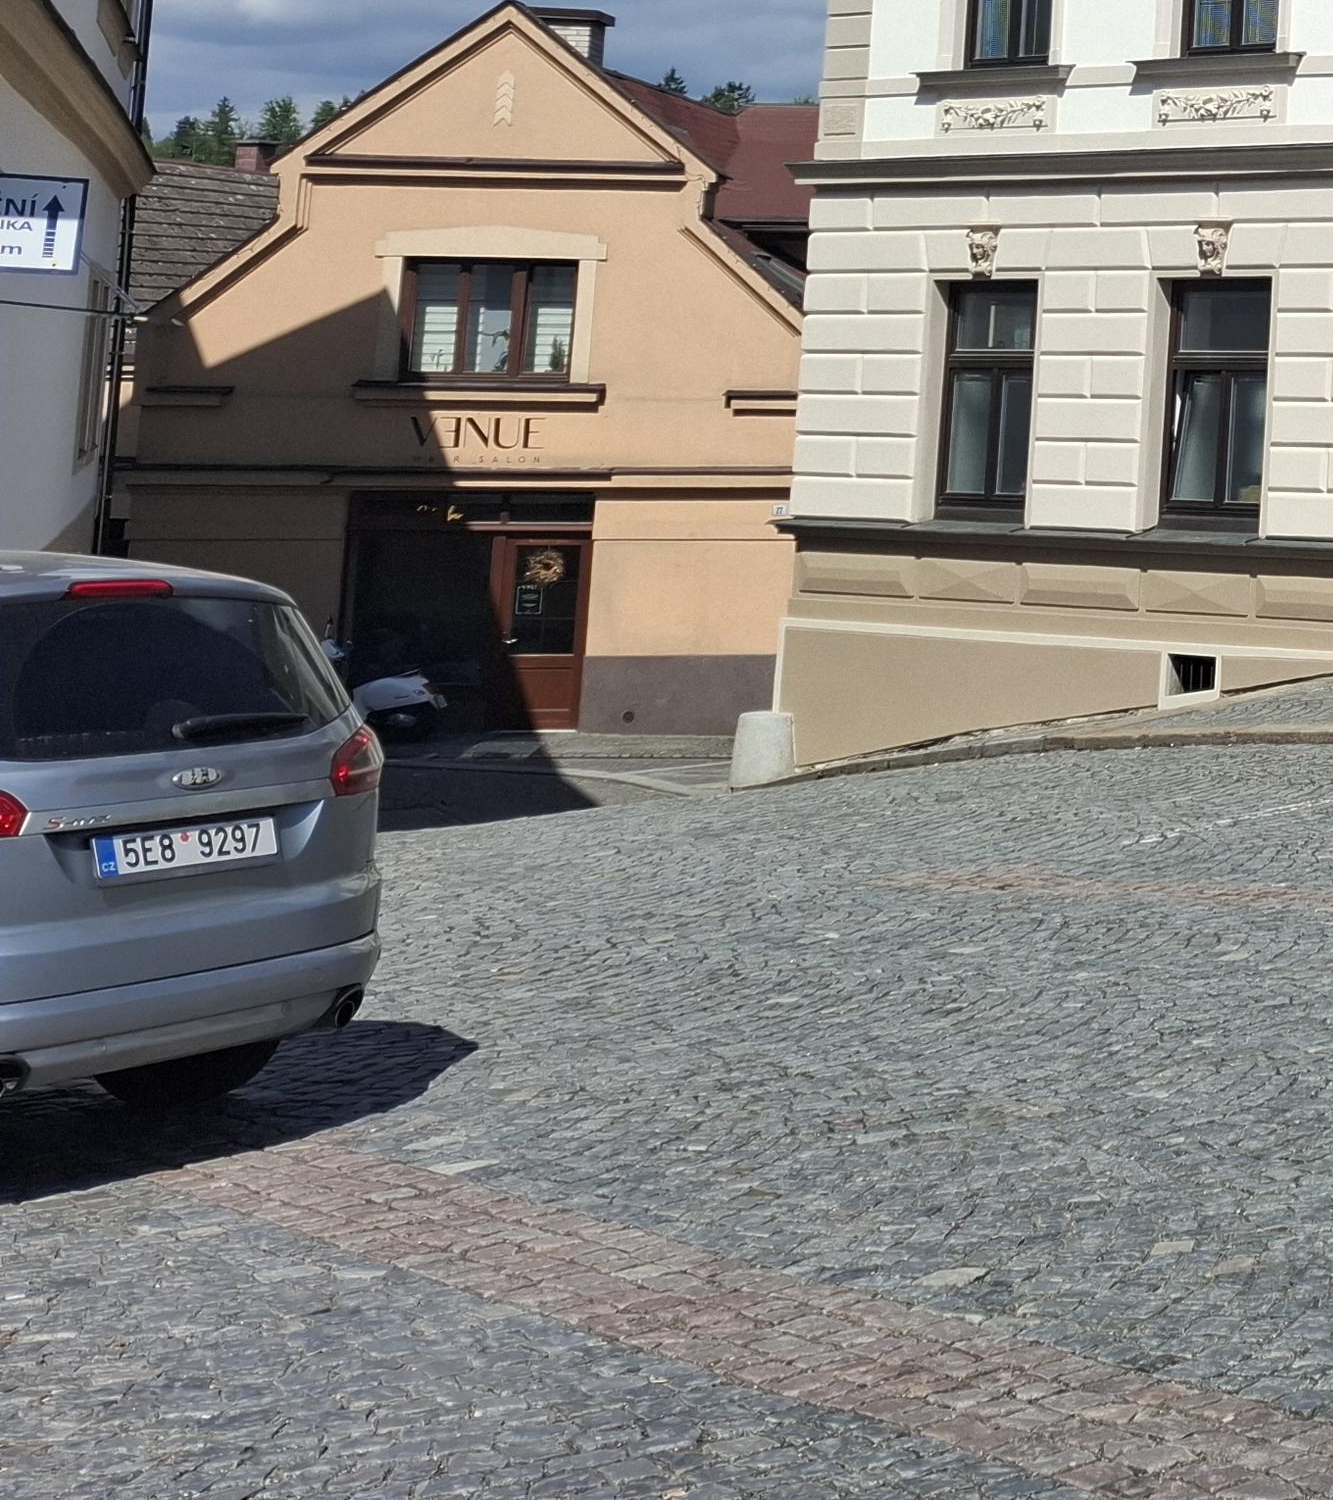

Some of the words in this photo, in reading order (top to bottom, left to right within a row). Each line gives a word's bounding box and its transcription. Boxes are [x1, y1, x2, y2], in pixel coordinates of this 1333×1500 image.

[0, 190, 39, 217] NÍ
[479, 455, 541, 464] SALON
[122, 833, 176, 868] 5E8
[198, 823, 261, 858] 9297
[102, 862, 117, 873] CZ
